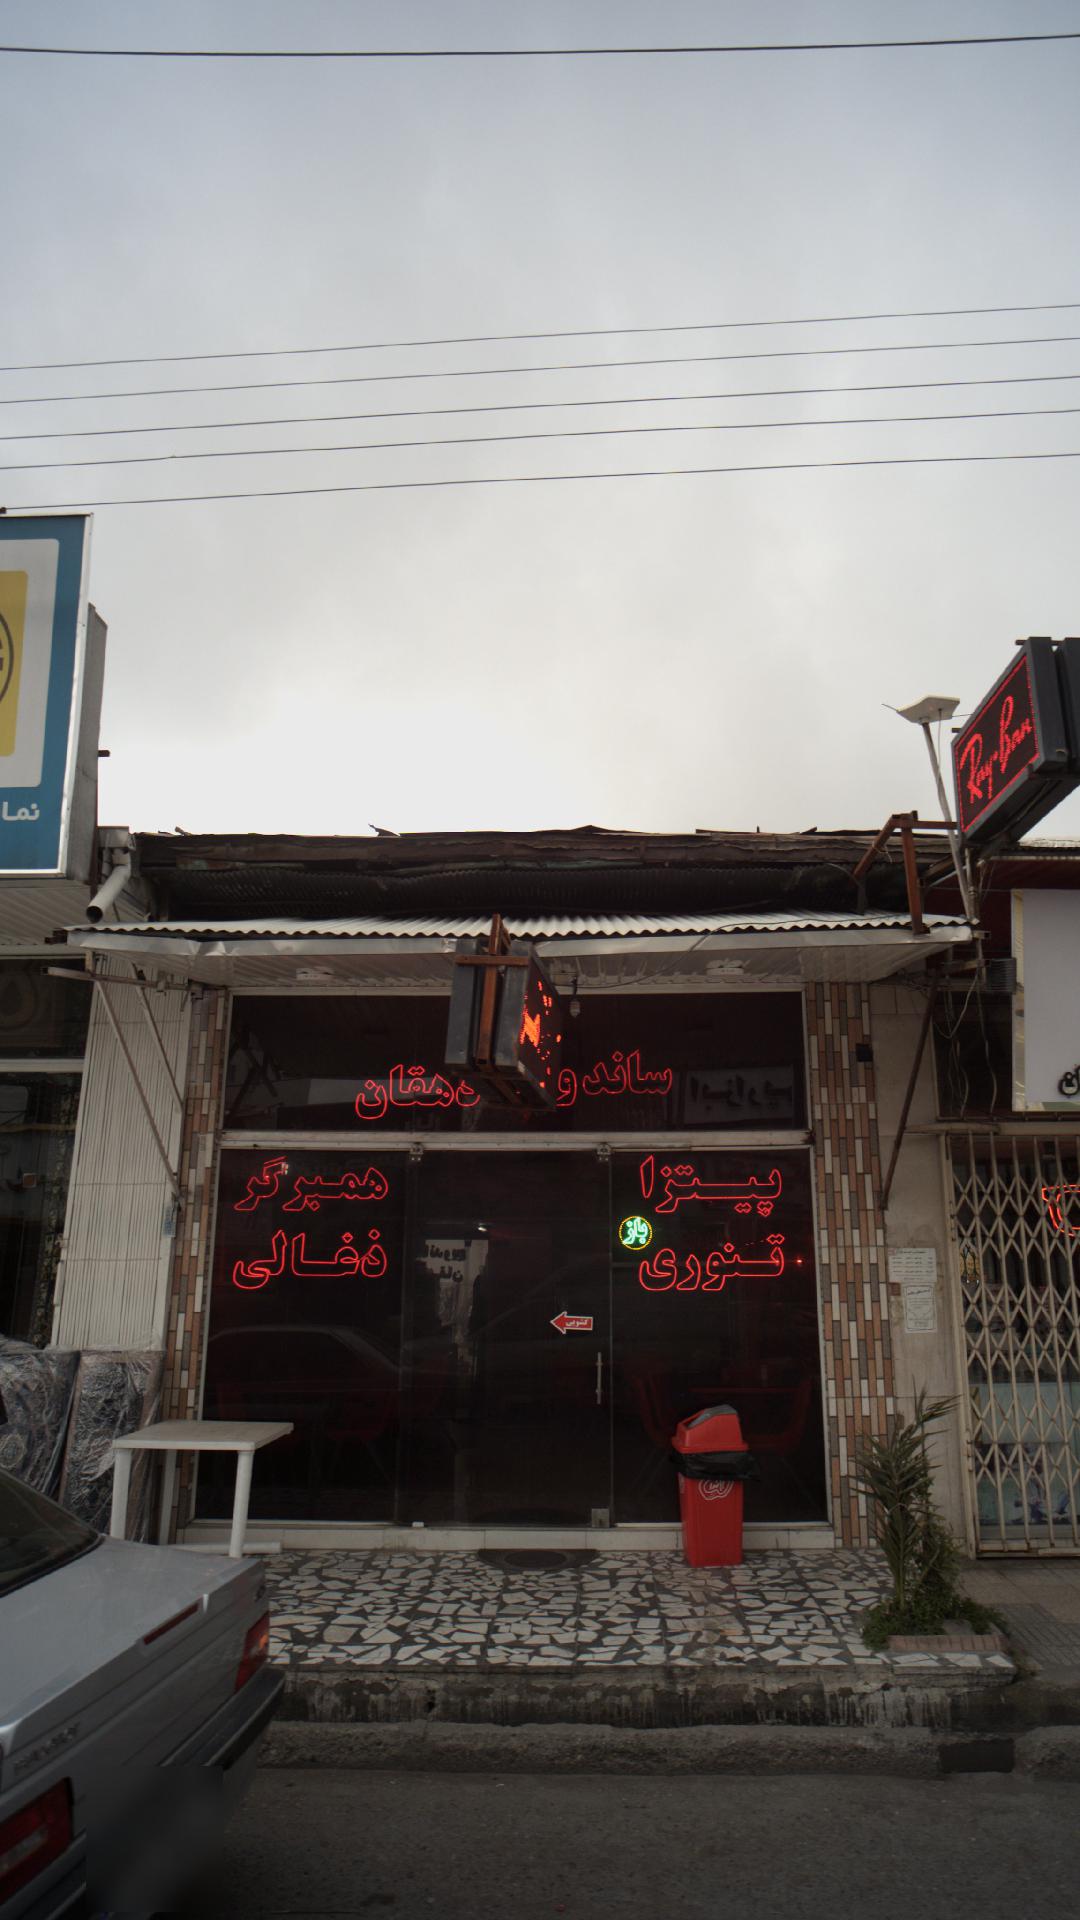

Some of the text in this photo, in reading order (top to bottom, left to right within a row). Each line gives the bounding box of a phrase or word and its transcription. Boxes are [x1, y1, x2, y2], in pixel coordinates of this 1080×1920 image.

[354, 1063, 481, 1120] دهقان
[555, 1049, 673, 1107] ساندو
[233, 1155, 389, 1211] همبرگر
[640, 1155, 783, 1217] پیتزا
[232, 1228, 388, 1289] ذغالی
[622, 1216, 649, 1245] باز
[639, 1233, 785, 1291] تنوری
